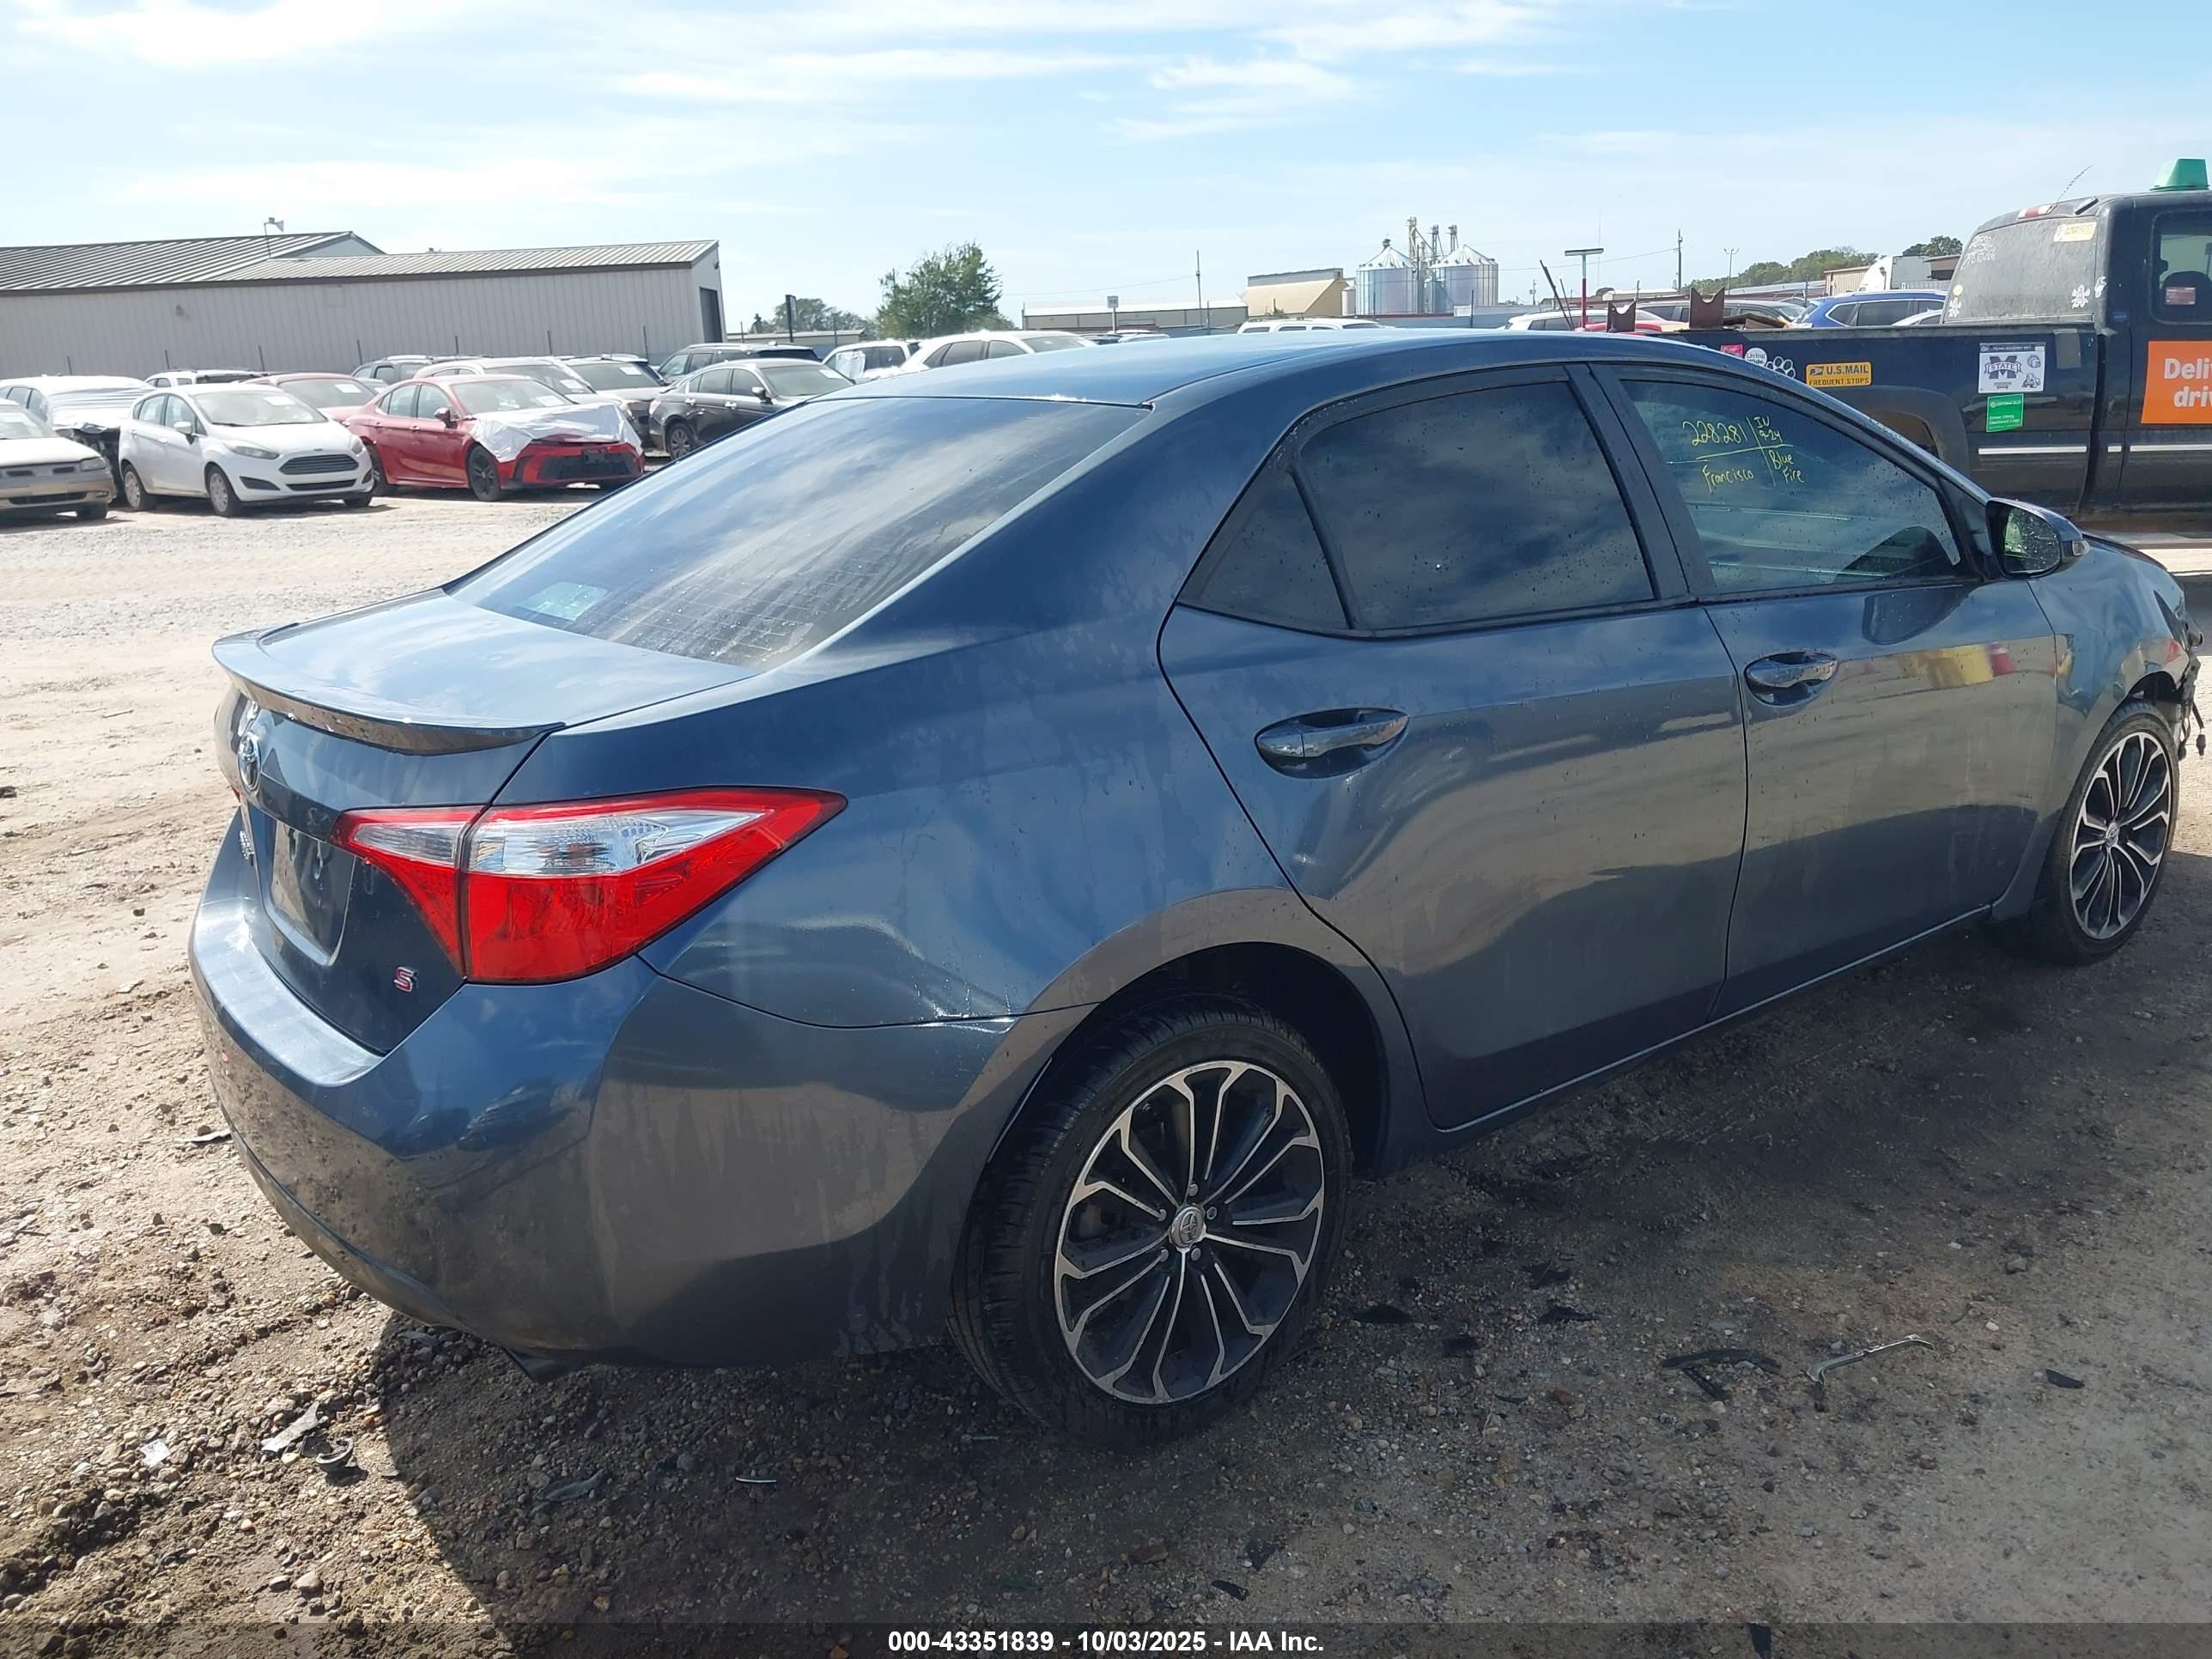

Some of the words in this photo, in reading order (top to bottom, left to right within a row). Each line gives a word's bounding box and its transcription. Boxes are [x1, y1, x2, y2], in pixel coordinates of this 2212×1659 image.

[1990, 362, 2016, 371] STATE
[2164, 357, 2212, 380] Deli
[1753, 416, 1771, 429] IN
[1768, 449, 1795, 471] Blue
[1702, 464, 1754, 494] Francisco
[393, 966, 413, 992] S
